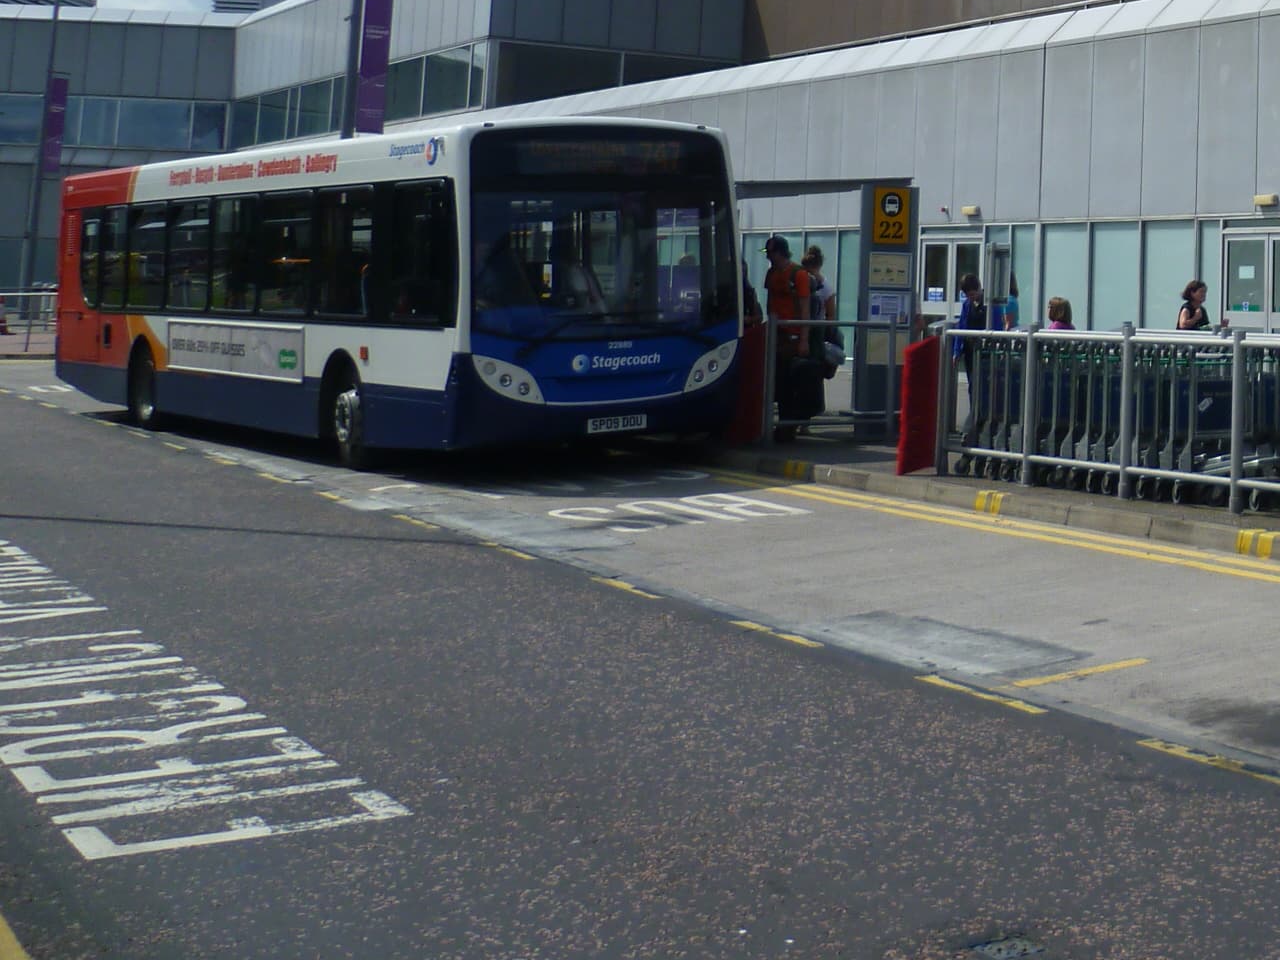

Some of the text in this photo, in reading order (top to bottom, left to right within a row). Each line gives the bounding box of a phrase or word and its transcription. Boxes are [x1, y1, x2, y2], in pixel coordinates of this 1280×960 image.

[389, 142, 425, 160] Stagecoach
[880, 221, 903, 239] 22
[592, 352, 661, 370] Stagecoach
[591, 417, 620, 431] SP09
[547, 492, 813, 532] BUS
[0, 628, 414, 861] EMERGENCY
